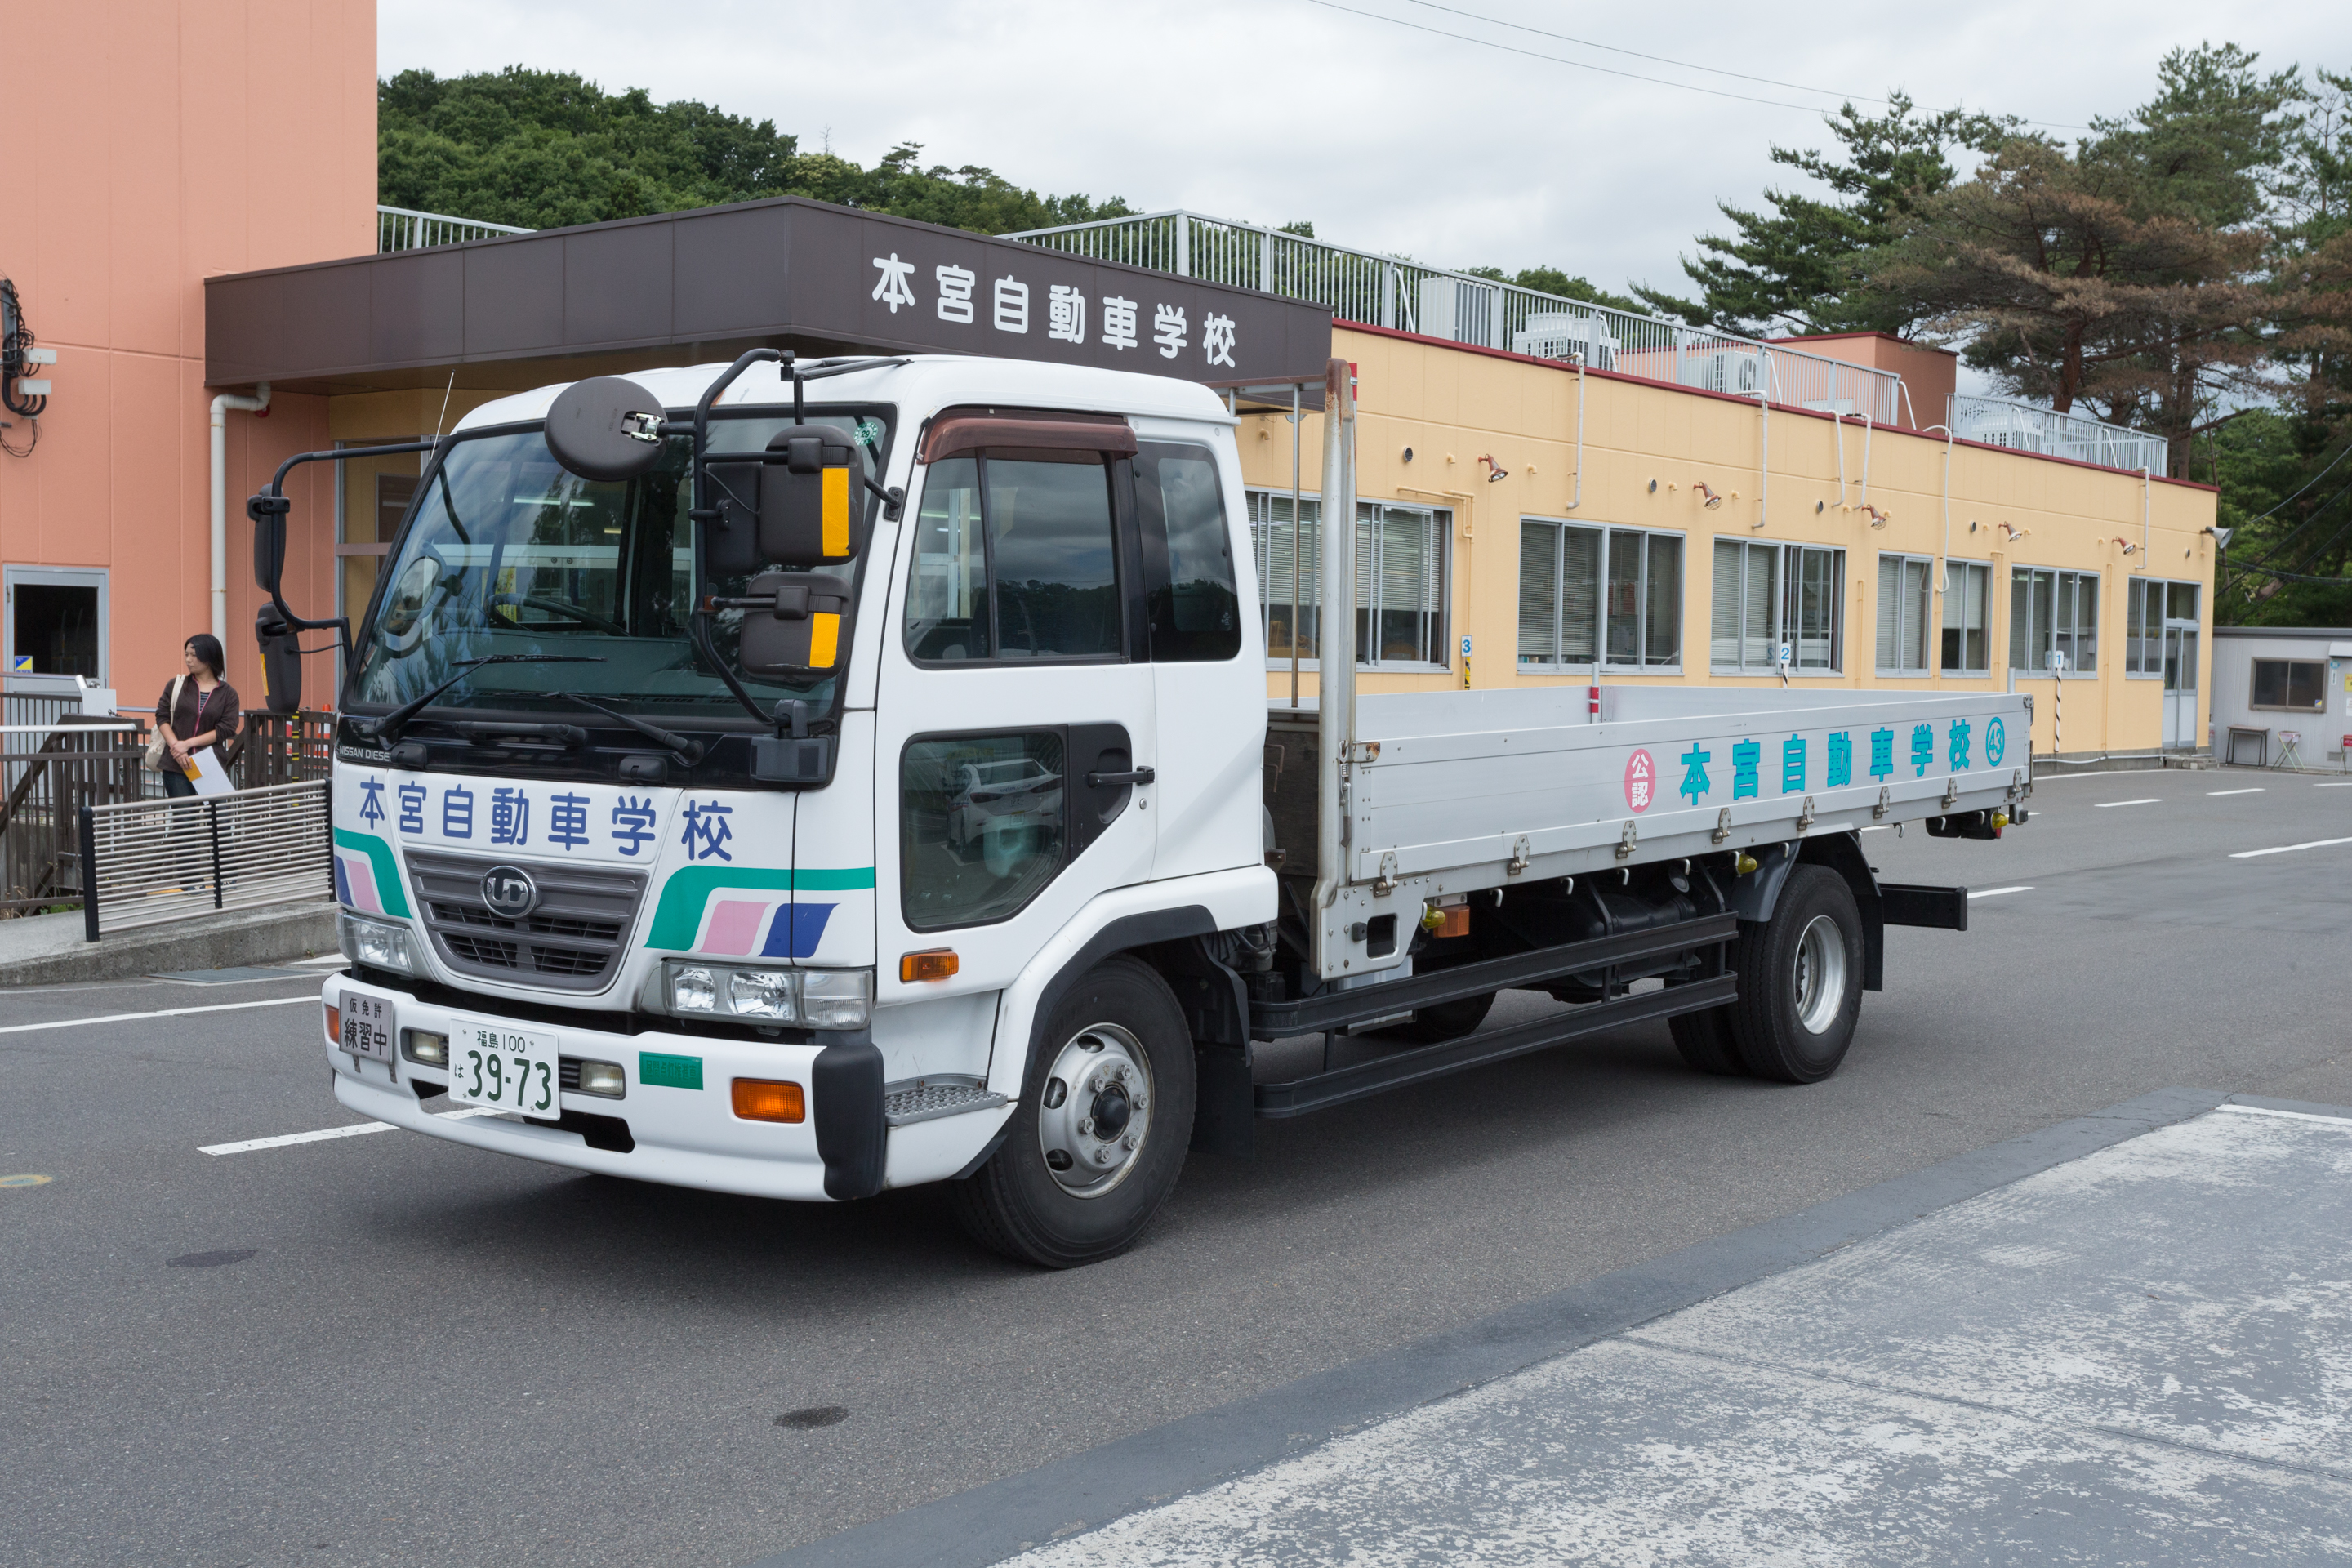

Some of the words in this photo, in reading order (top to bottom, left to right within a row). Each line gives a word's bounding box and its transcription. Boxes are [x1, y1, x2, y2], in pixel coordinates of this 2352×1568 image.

[872, 252, 1236, 368] 本宮自動車学校
[1463, 639, 1471, 653] 3
[1781, 648, 1789, 659] 2
[2056, 655, 2060, 664] 1
[339, 746, 363, 758] NISSAN
[1680, 719, 1970, 805] 本宮自動車学校
[1632, 754, 1649, 808] 公認
[359, 775, 733, 862] 本宮自動車学校
[487, 877, 528, 907] UD
[350, 998, 381, 1018] 仮免許
[344, 1018, 386, 1056] 練習中
[477, 1030, 498, 1049] 福島
[503, 1034, 525, 1053] 100
[455, 1063, 464, 1078] は
[468, 1050, 551, 1110] 39-73
